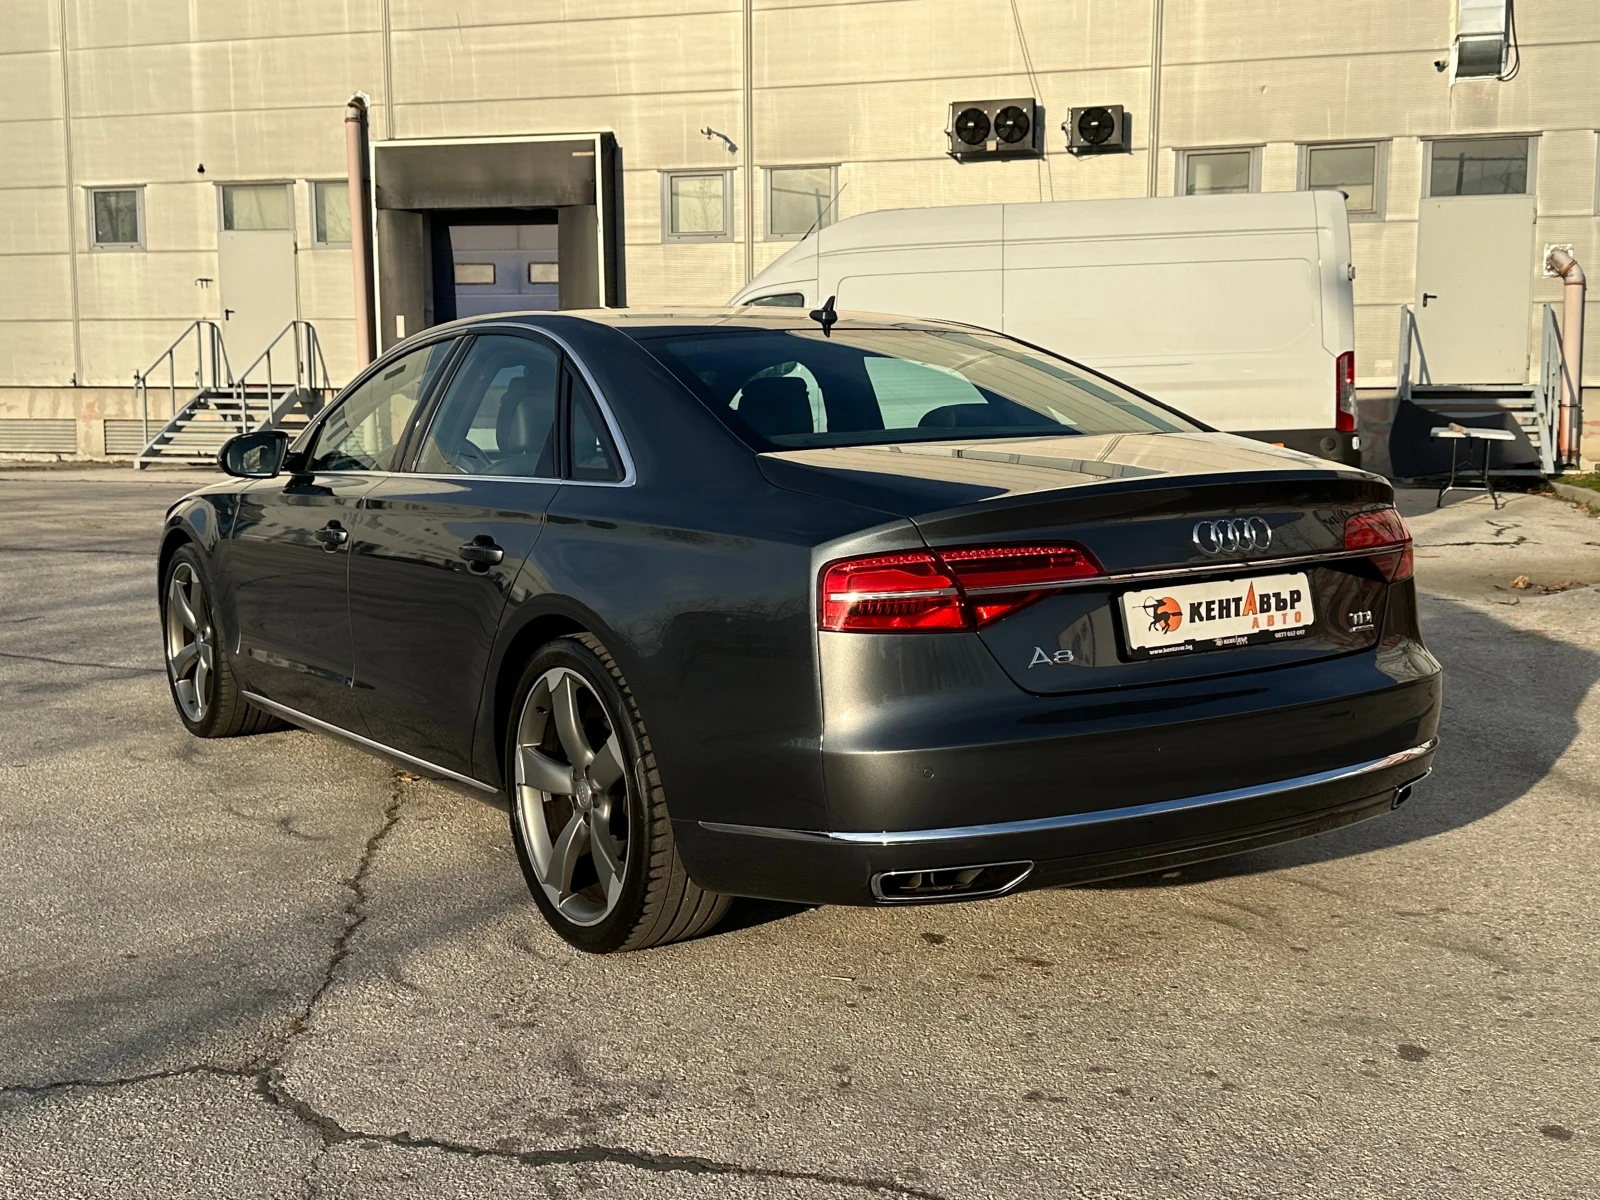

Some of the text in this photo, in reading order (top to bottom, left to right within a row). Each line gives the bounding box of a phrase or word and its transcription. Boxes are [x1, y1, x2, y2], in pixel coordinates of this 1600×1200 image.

[1189, 580, 1302, 623] КЕНТАВЪР
[1251, 611, 1302, 629] АВТО
[1027, 646, 1074, 669] A8
